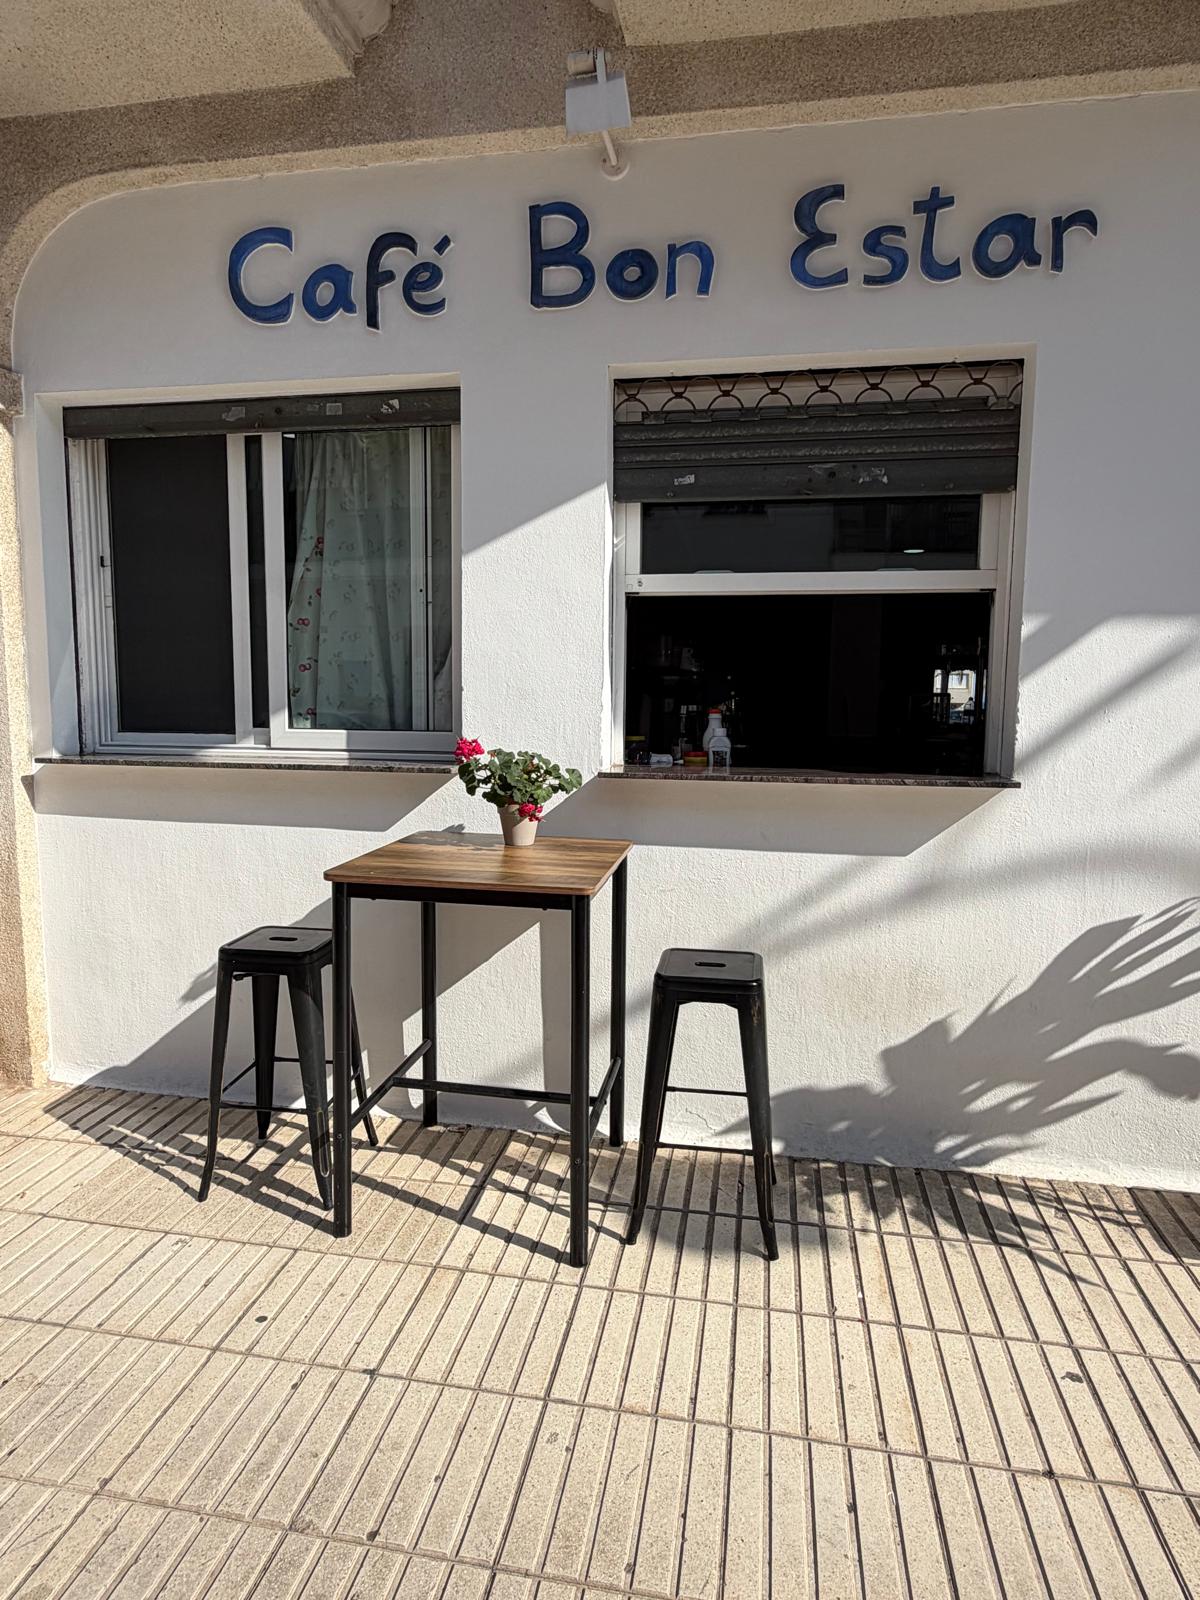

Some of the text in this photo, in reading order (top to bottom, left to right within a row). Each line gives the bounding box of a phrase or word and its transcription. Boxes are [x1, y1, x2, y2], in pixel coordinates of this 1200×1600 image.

[228, 183, 1098, 330] Café Bon Estar
